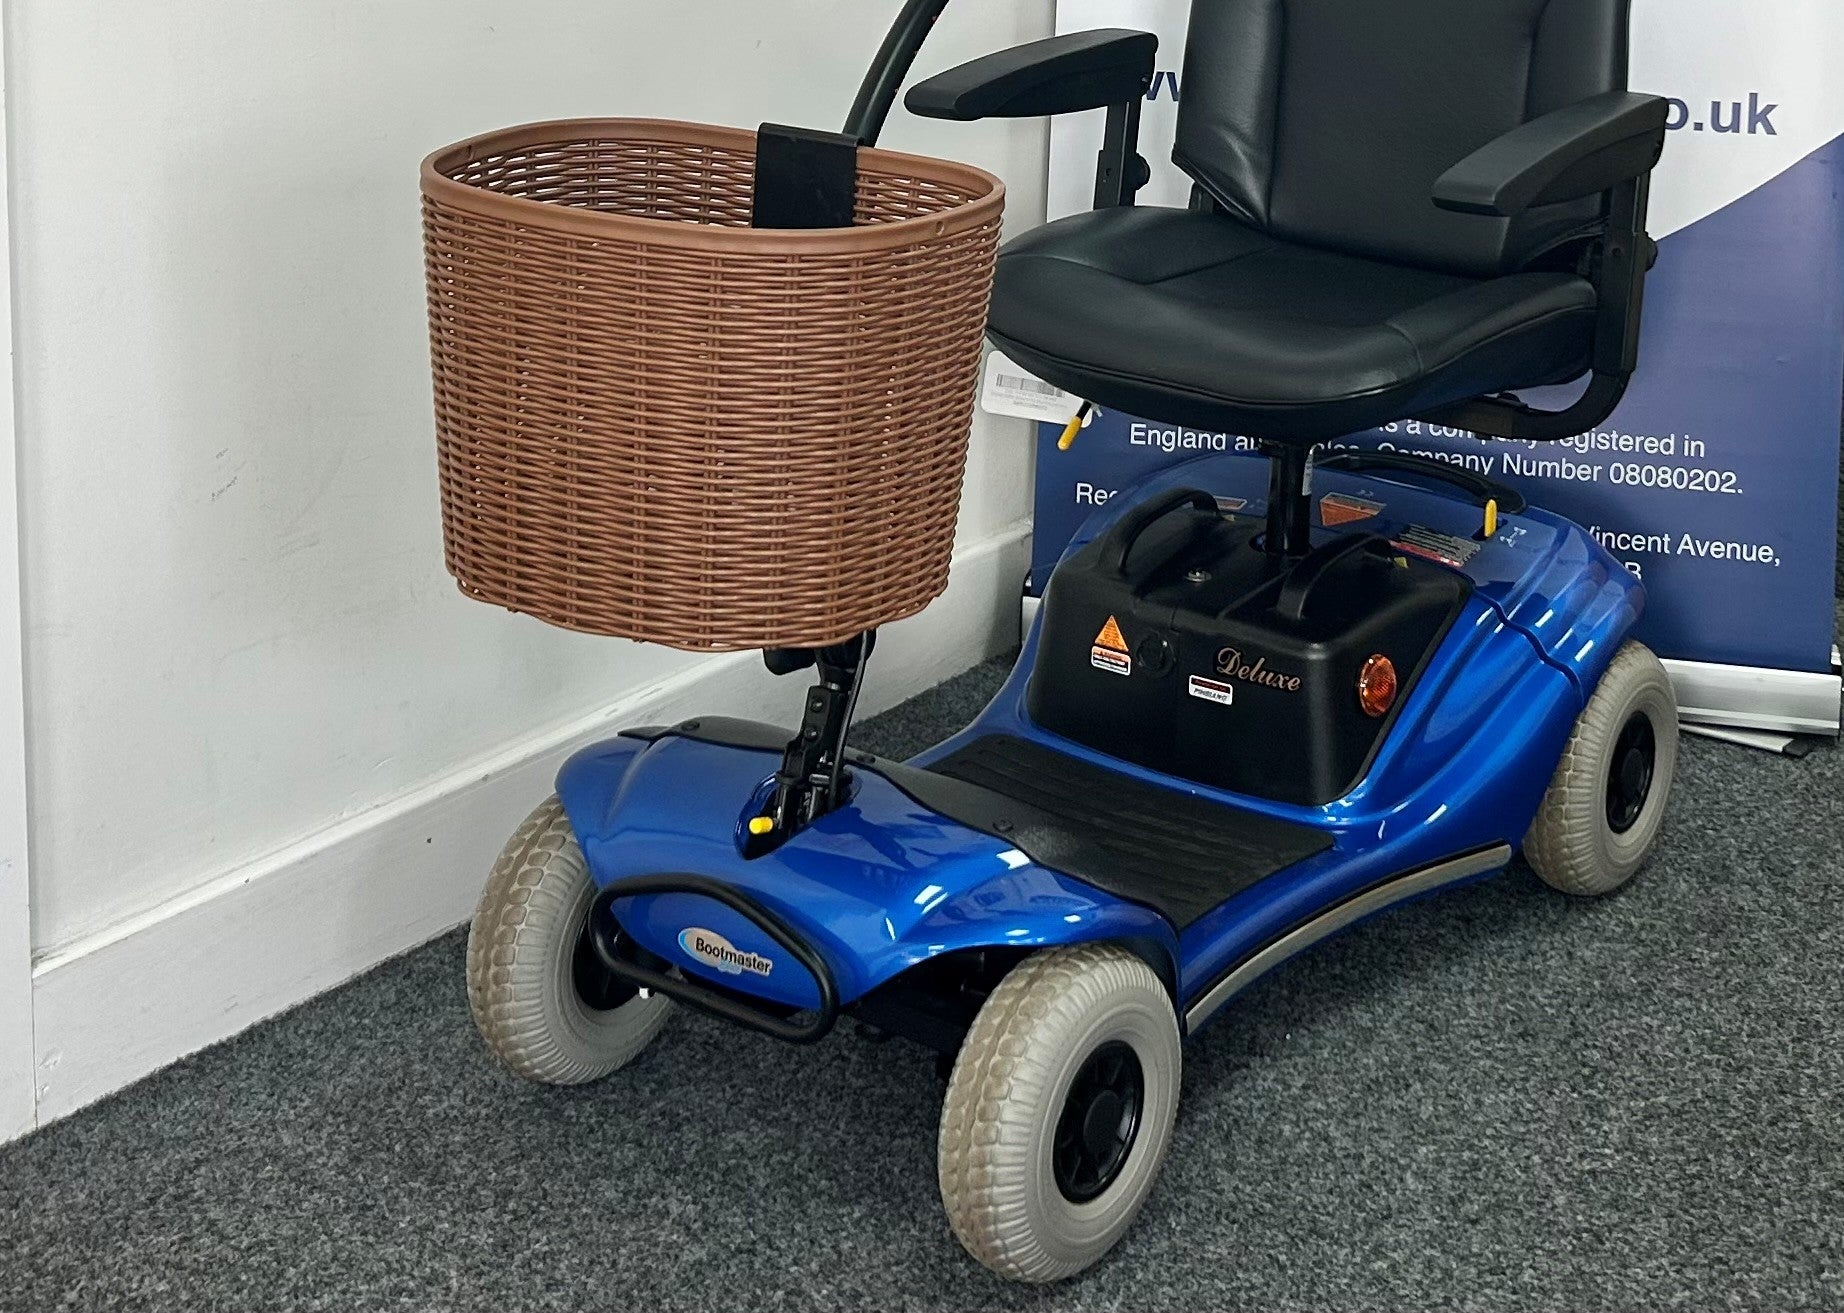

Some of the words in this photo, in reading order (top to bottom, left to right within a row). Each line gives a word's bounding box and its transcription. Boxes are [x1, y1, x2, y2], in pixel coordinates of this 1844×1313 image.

[1129, 423, 1227, 453] England
[1683, 434, 1705, 458] in
[1502, 452, 1603, 483] Number
[1609, 462, 1744, 495] 08080202.
[1589, 525, 1671, 555] incent
[1677, 533, 1781, 567] Avenue,
[1216, 647, 1301, 691] Deluxe
[695, 936, 771, 974] Bootmaster
